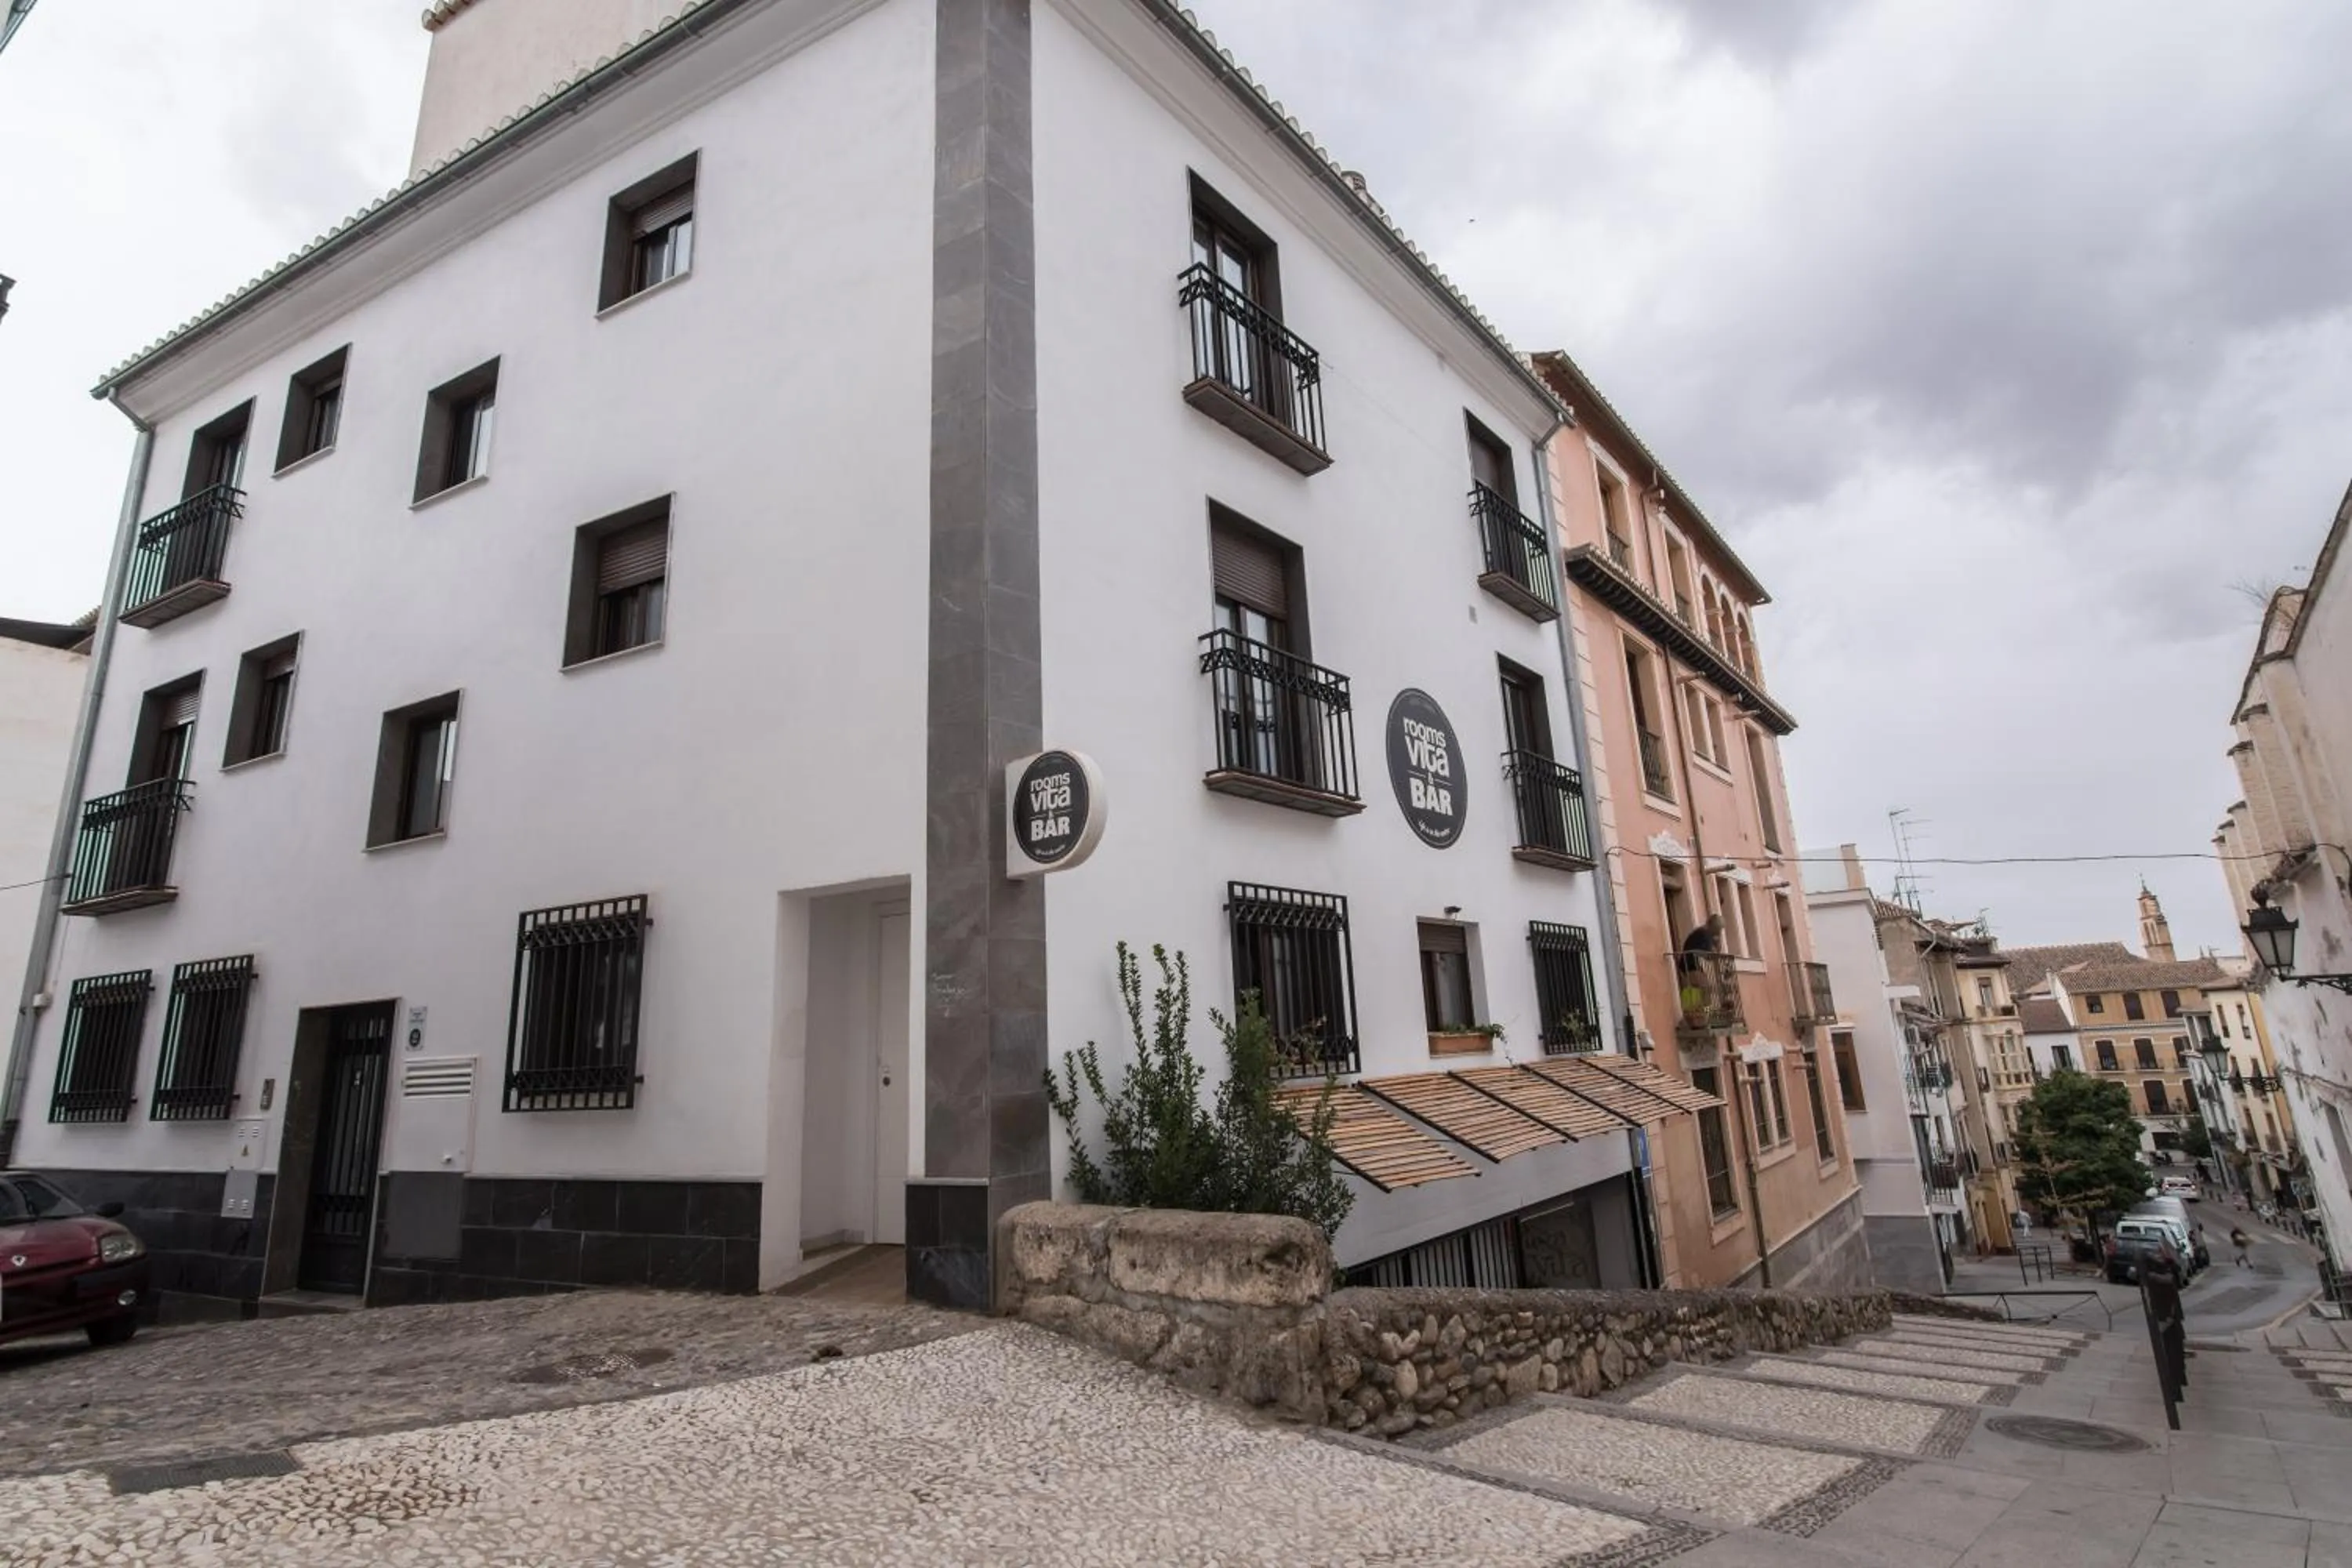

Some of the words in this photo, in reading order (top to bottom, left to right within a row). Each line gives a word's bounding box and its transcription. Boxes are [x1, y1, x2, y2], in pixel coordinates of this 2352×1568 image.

[1403, 717, 1446, 747] rooms
[1030, 772, 1071, 792] rooms
[1030, 786, 1072, 813] vita
[1410, 777, 1453, 816] BAR
[1031, 816, 1071, 841] BAR
